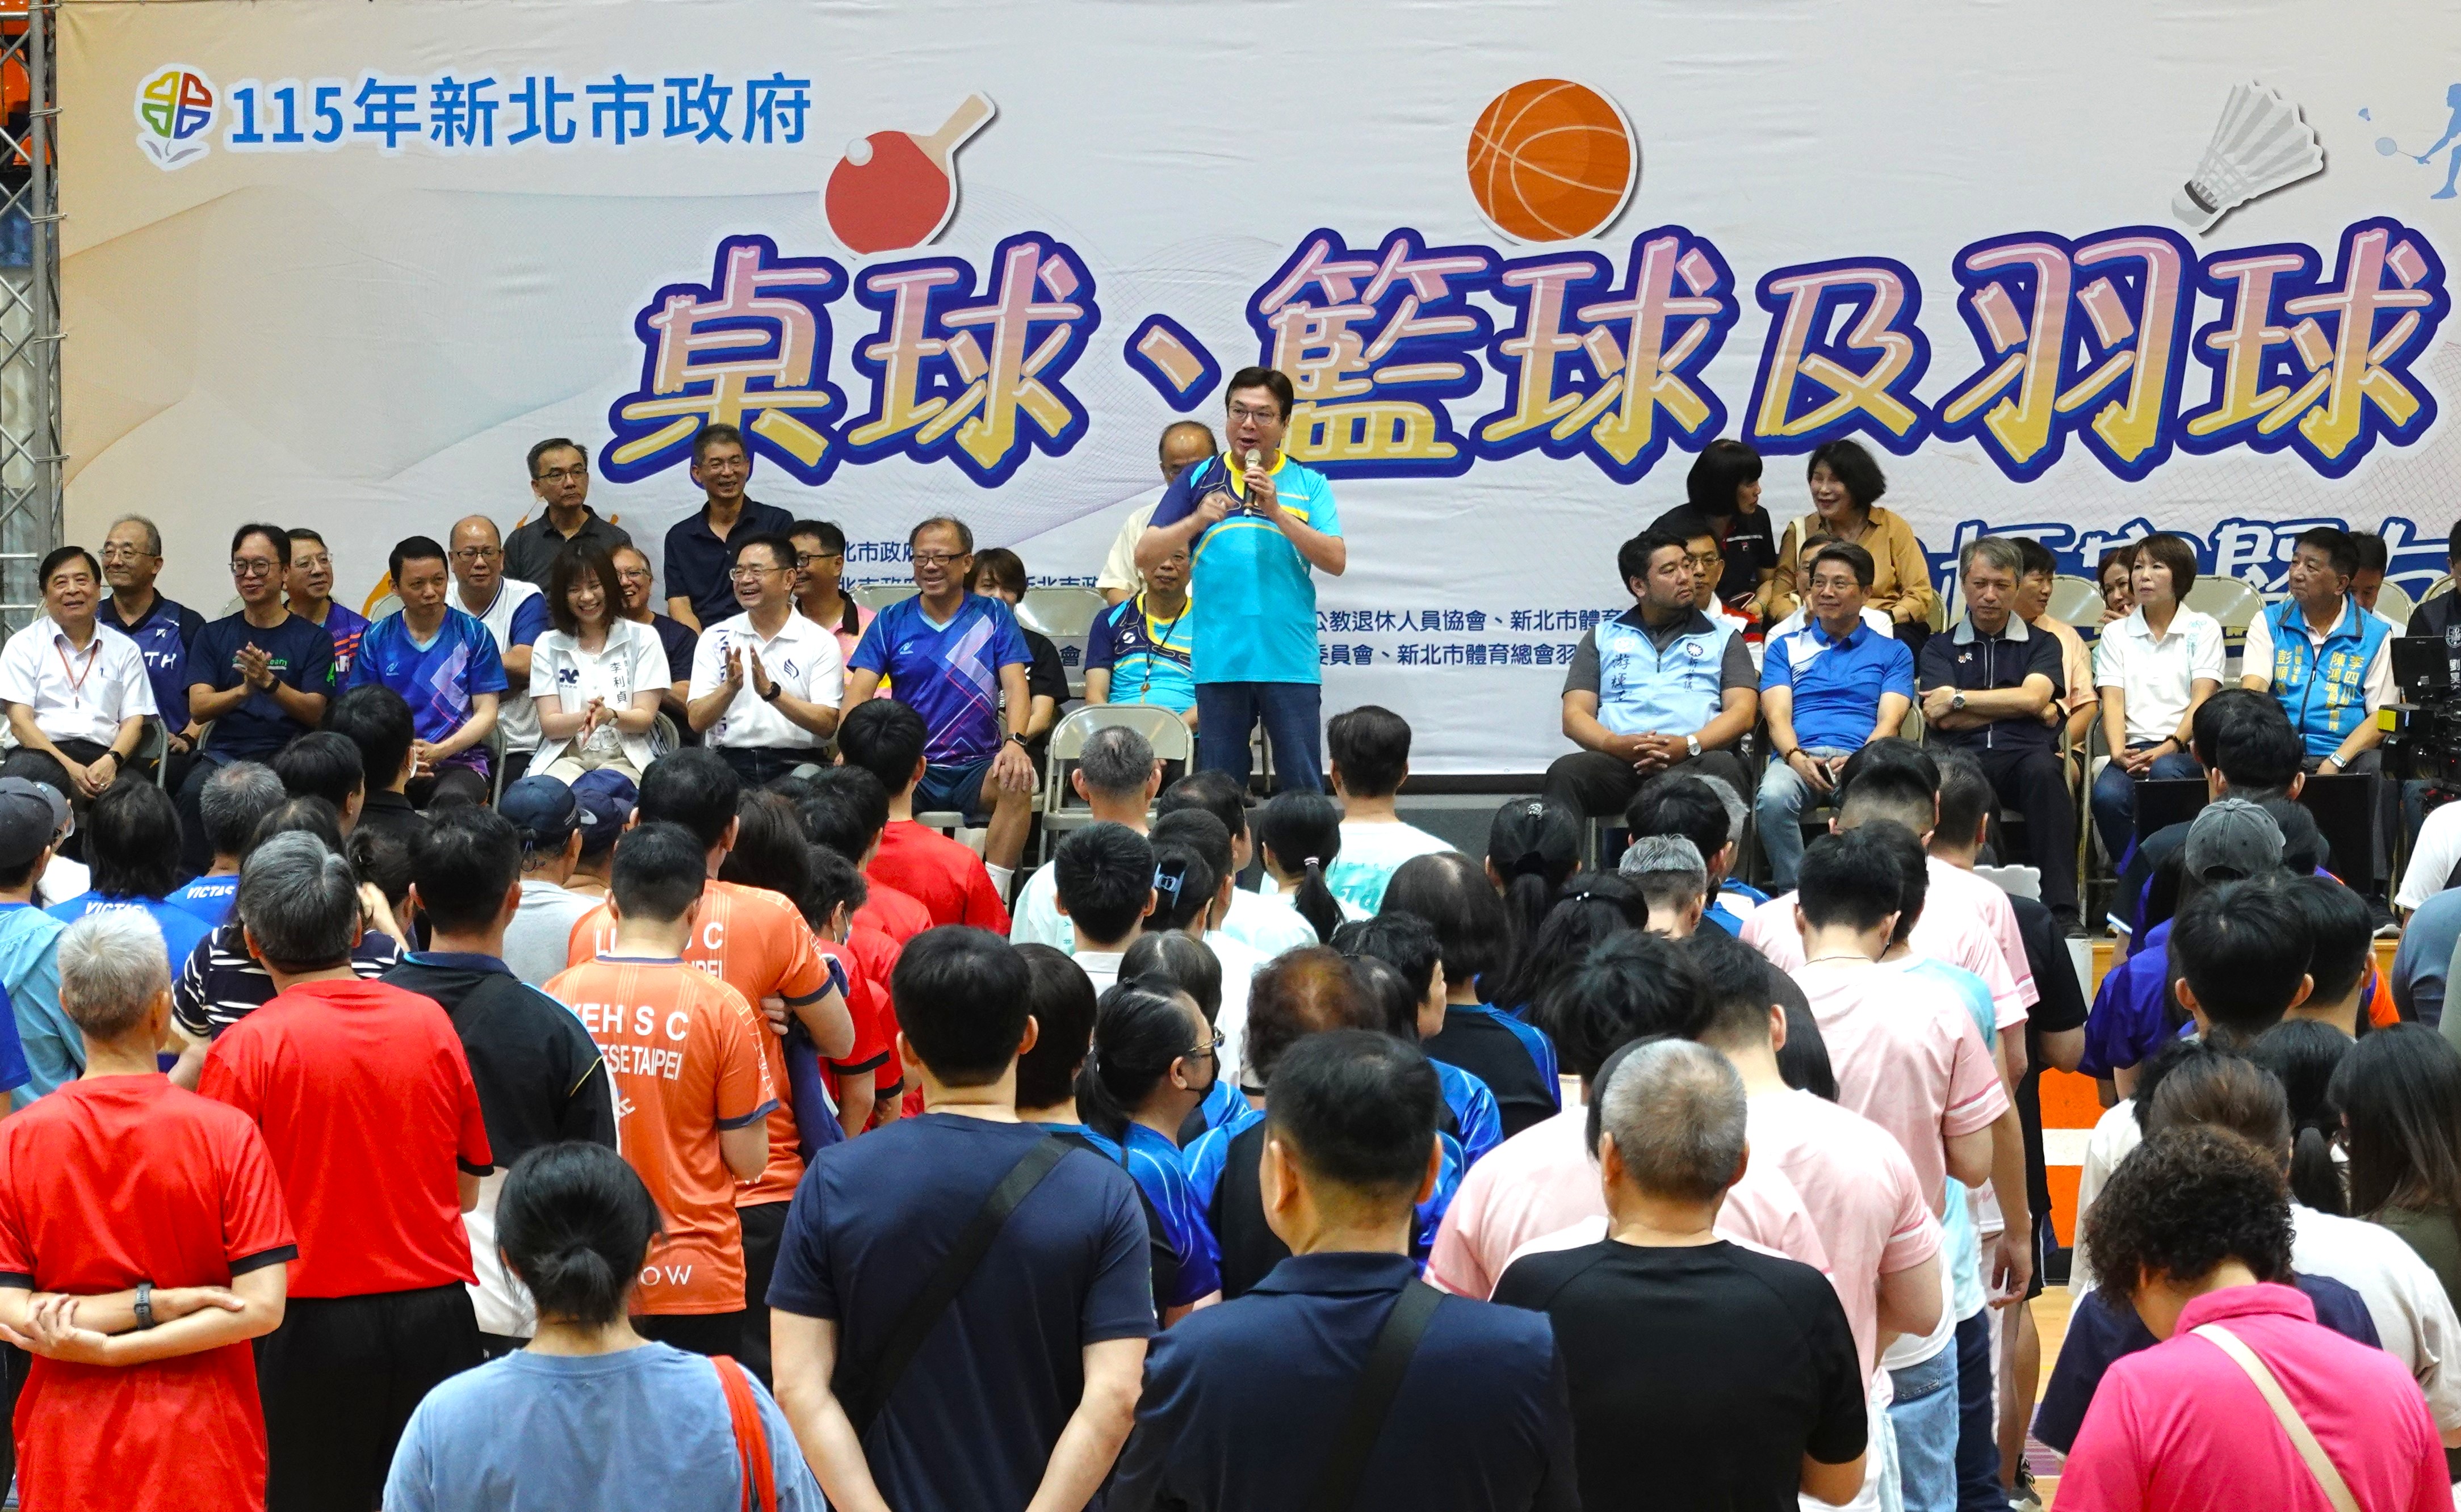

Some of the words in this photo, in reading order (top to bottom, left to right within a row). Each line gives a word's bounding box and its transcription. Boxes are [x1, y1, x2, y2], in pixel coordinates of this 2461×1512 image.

[230, 72, 812, 148] 115年新北市政府
[610, 662, 628, 704] 李利貞
[186, 885, 235, 900] VICTAS
[634, 1005, 655, 1036] S
[665, 1011, 689, 1041] C
[631, 1046, 683, 1081] TAIPEI
